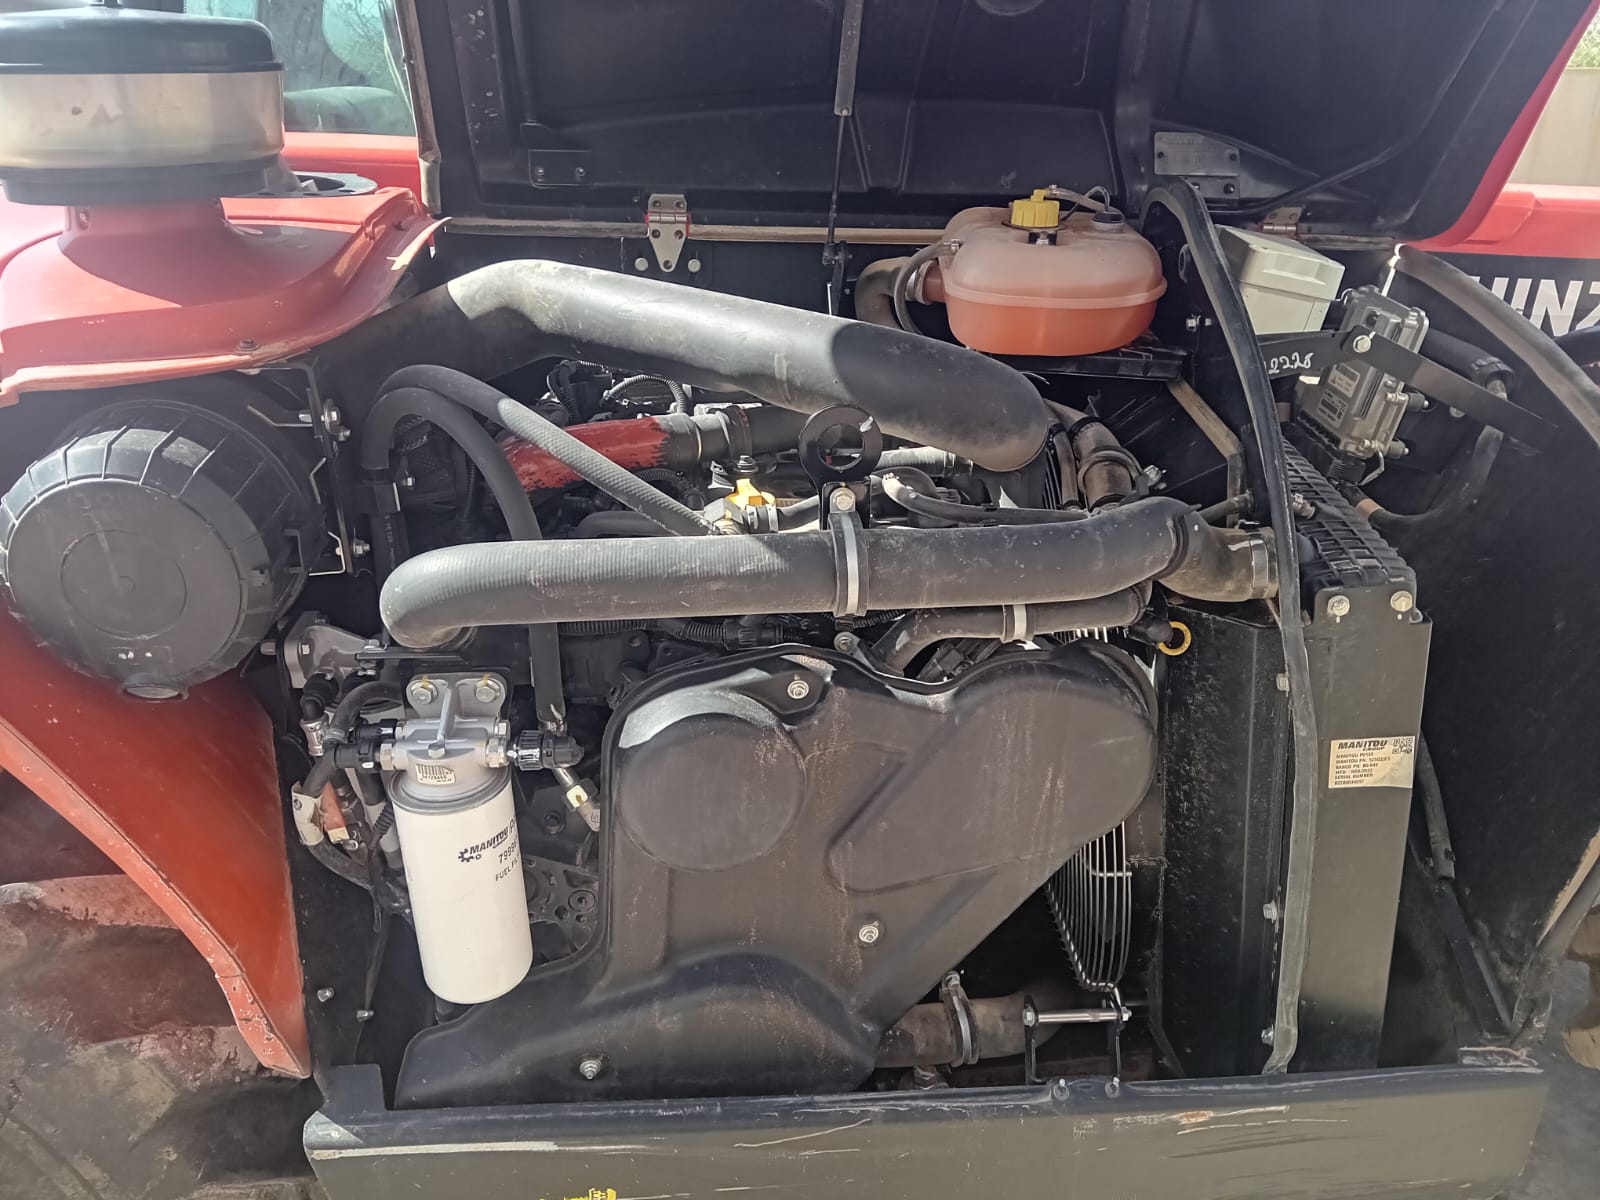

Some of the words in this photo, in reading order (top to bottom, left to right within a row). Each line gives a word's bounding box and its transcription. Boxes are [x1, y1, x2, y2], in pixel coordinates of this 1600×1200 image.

[1338, 740, 1388, 749] MANITOU
[469, 826, 508, 855] MANITOU
[495, 866, 511, 881] FUEL
